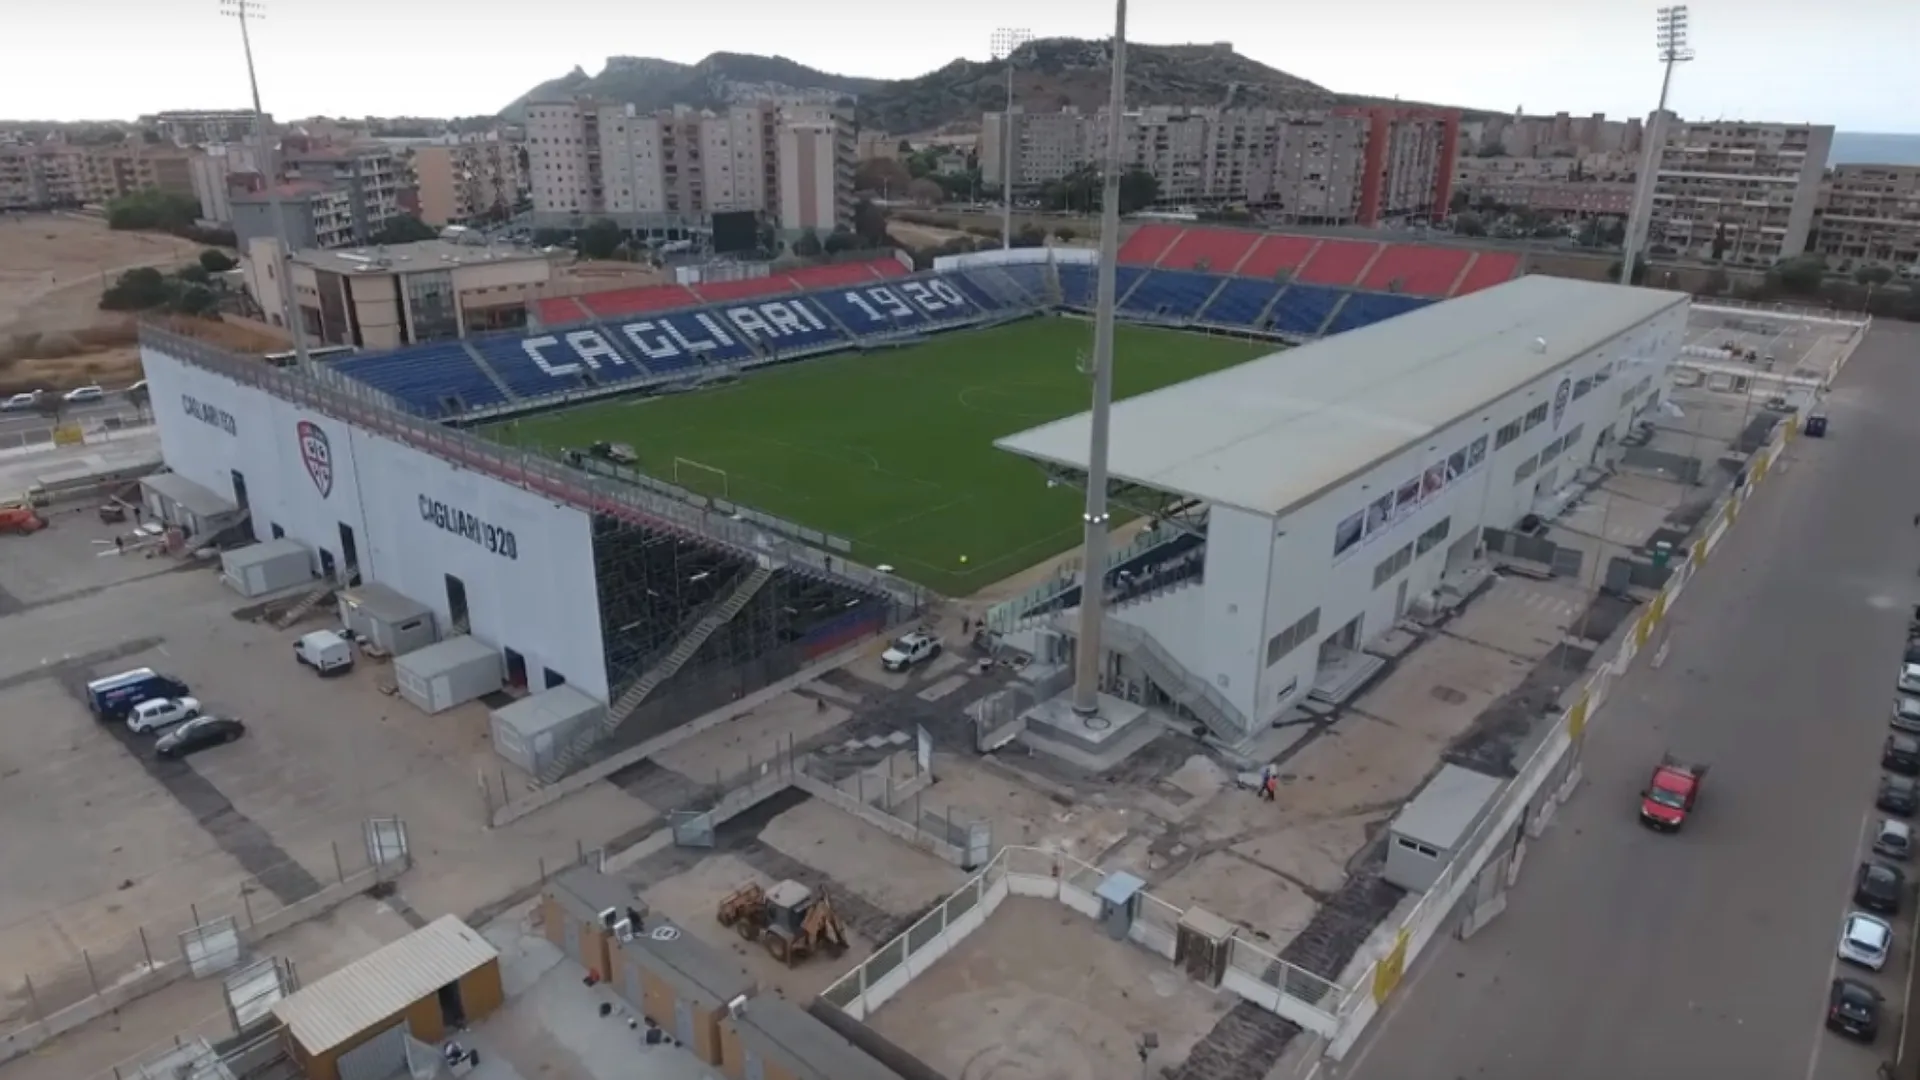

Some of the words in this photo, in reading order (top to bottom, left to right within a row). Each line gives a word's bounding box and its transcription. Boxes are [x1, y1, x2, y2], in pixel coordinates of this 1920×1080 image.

[521, 300, 825, 376] CAGLIARI
[845, 279, 964, 322] 1920
[418, 493, 482, 546] CAGLIARI
[481, 521, 518, 560] 1920
